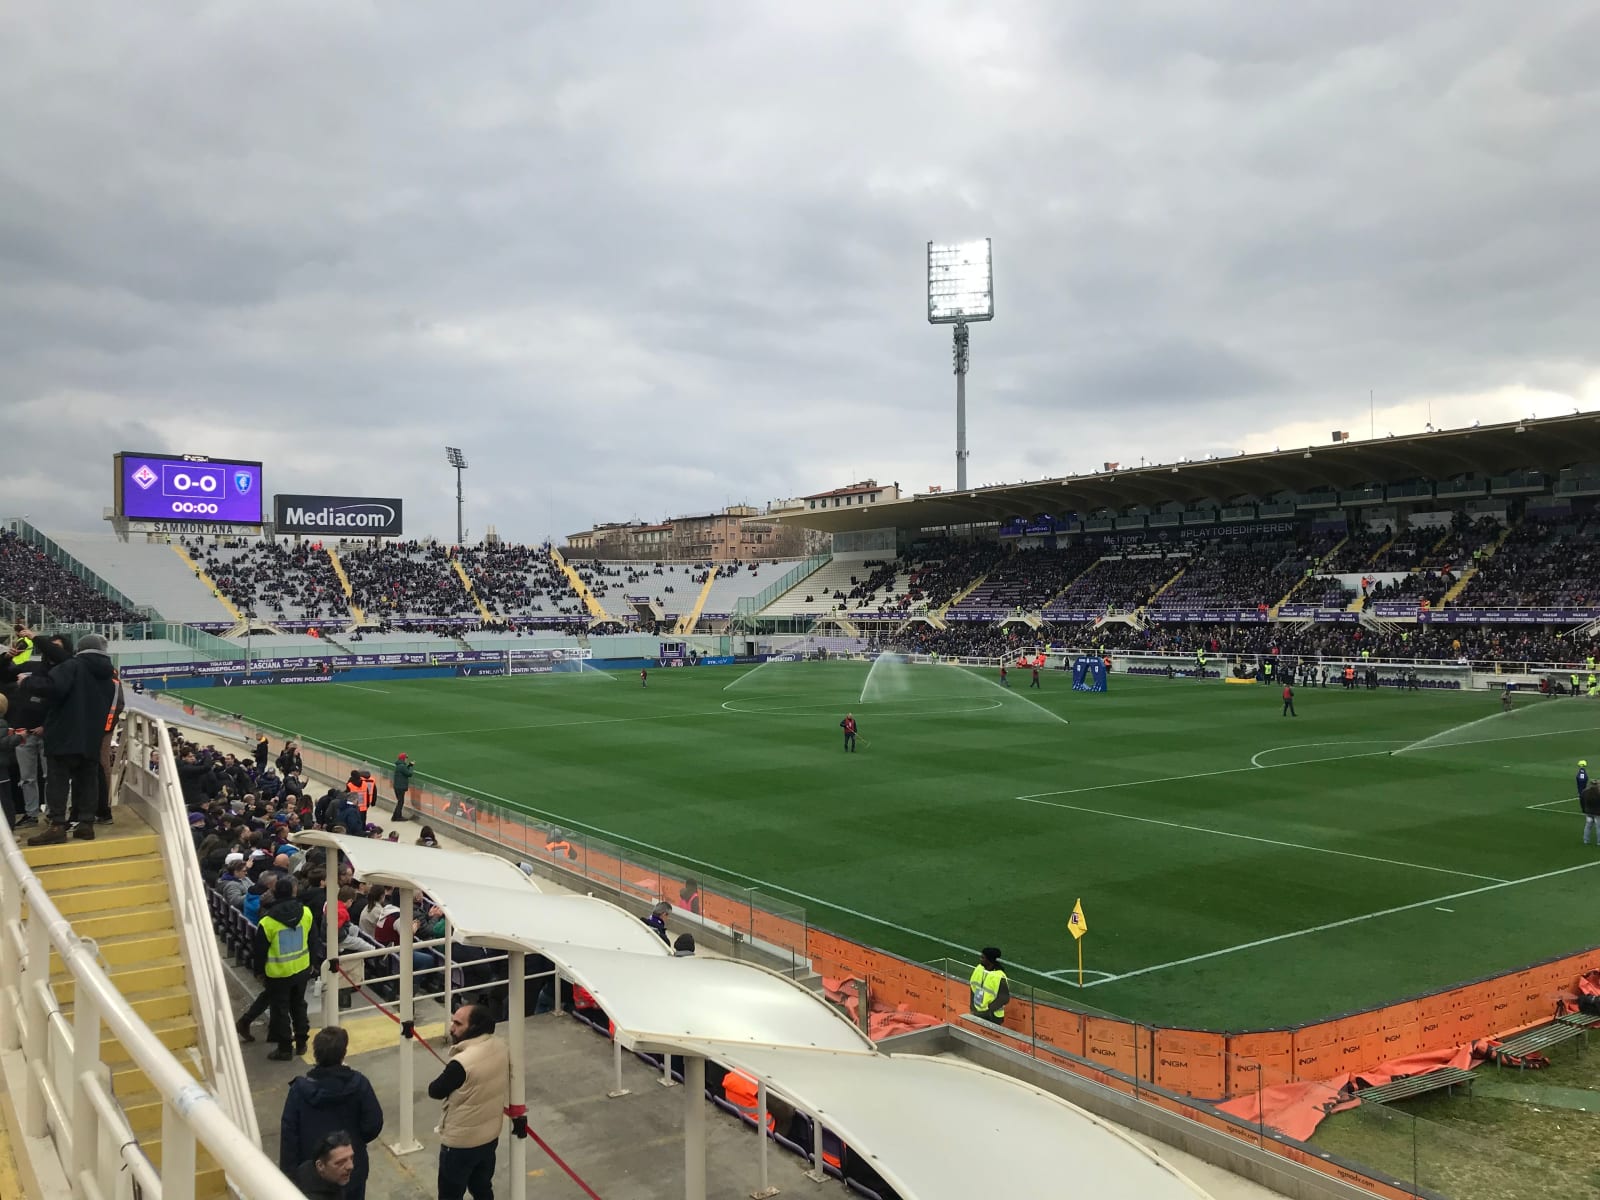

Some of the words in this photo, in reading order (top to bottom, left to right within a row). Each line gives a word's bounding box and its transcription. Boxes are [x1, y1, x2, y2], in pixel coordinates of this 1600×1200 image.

[173, 473, 217, 493] 0-0
[171, 501, 219, 515] 00:00
[285, 505, 386, 529] Mediacom
[154, 521, 234, 535] SAMMONTANA
[1095, 1048, 1116, 1057] NGM
[1165, 1060, 1188, 1069] NGM
[1301, 1056, 1318, 1066] NGM
